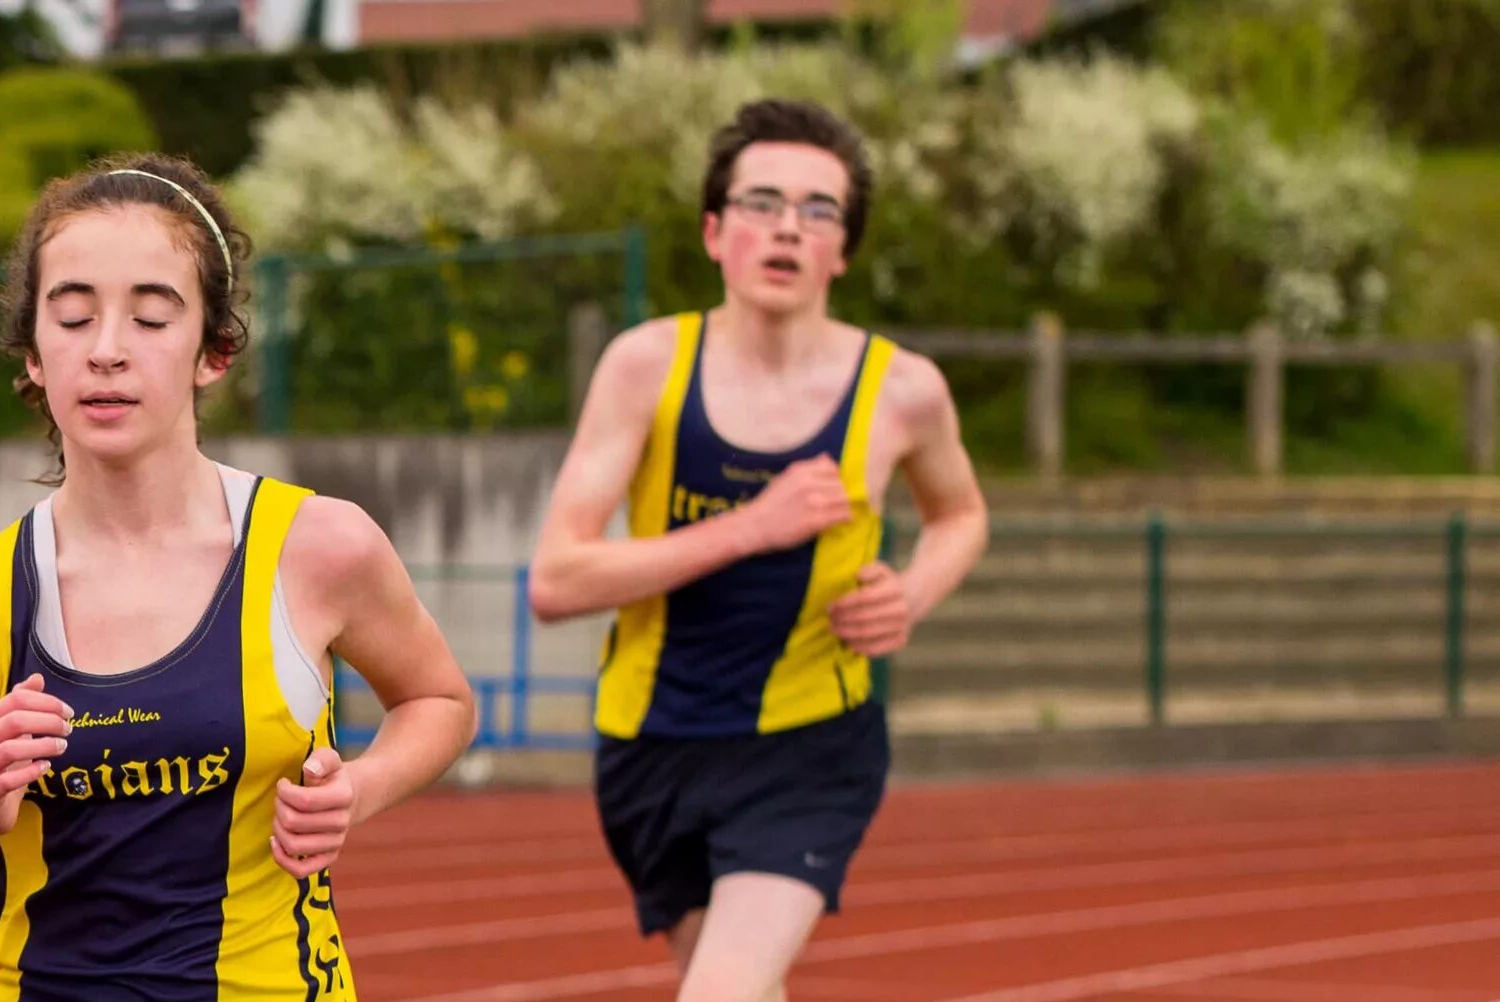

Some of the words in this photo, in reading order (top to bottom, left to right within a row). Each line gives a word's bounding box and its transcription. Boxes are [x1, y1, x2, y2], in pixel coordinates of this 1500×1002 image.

[67, 708, 125, 728] echnical
[127, 707, 162, 723] Wear
[26, 746, 230, 800] rojans
